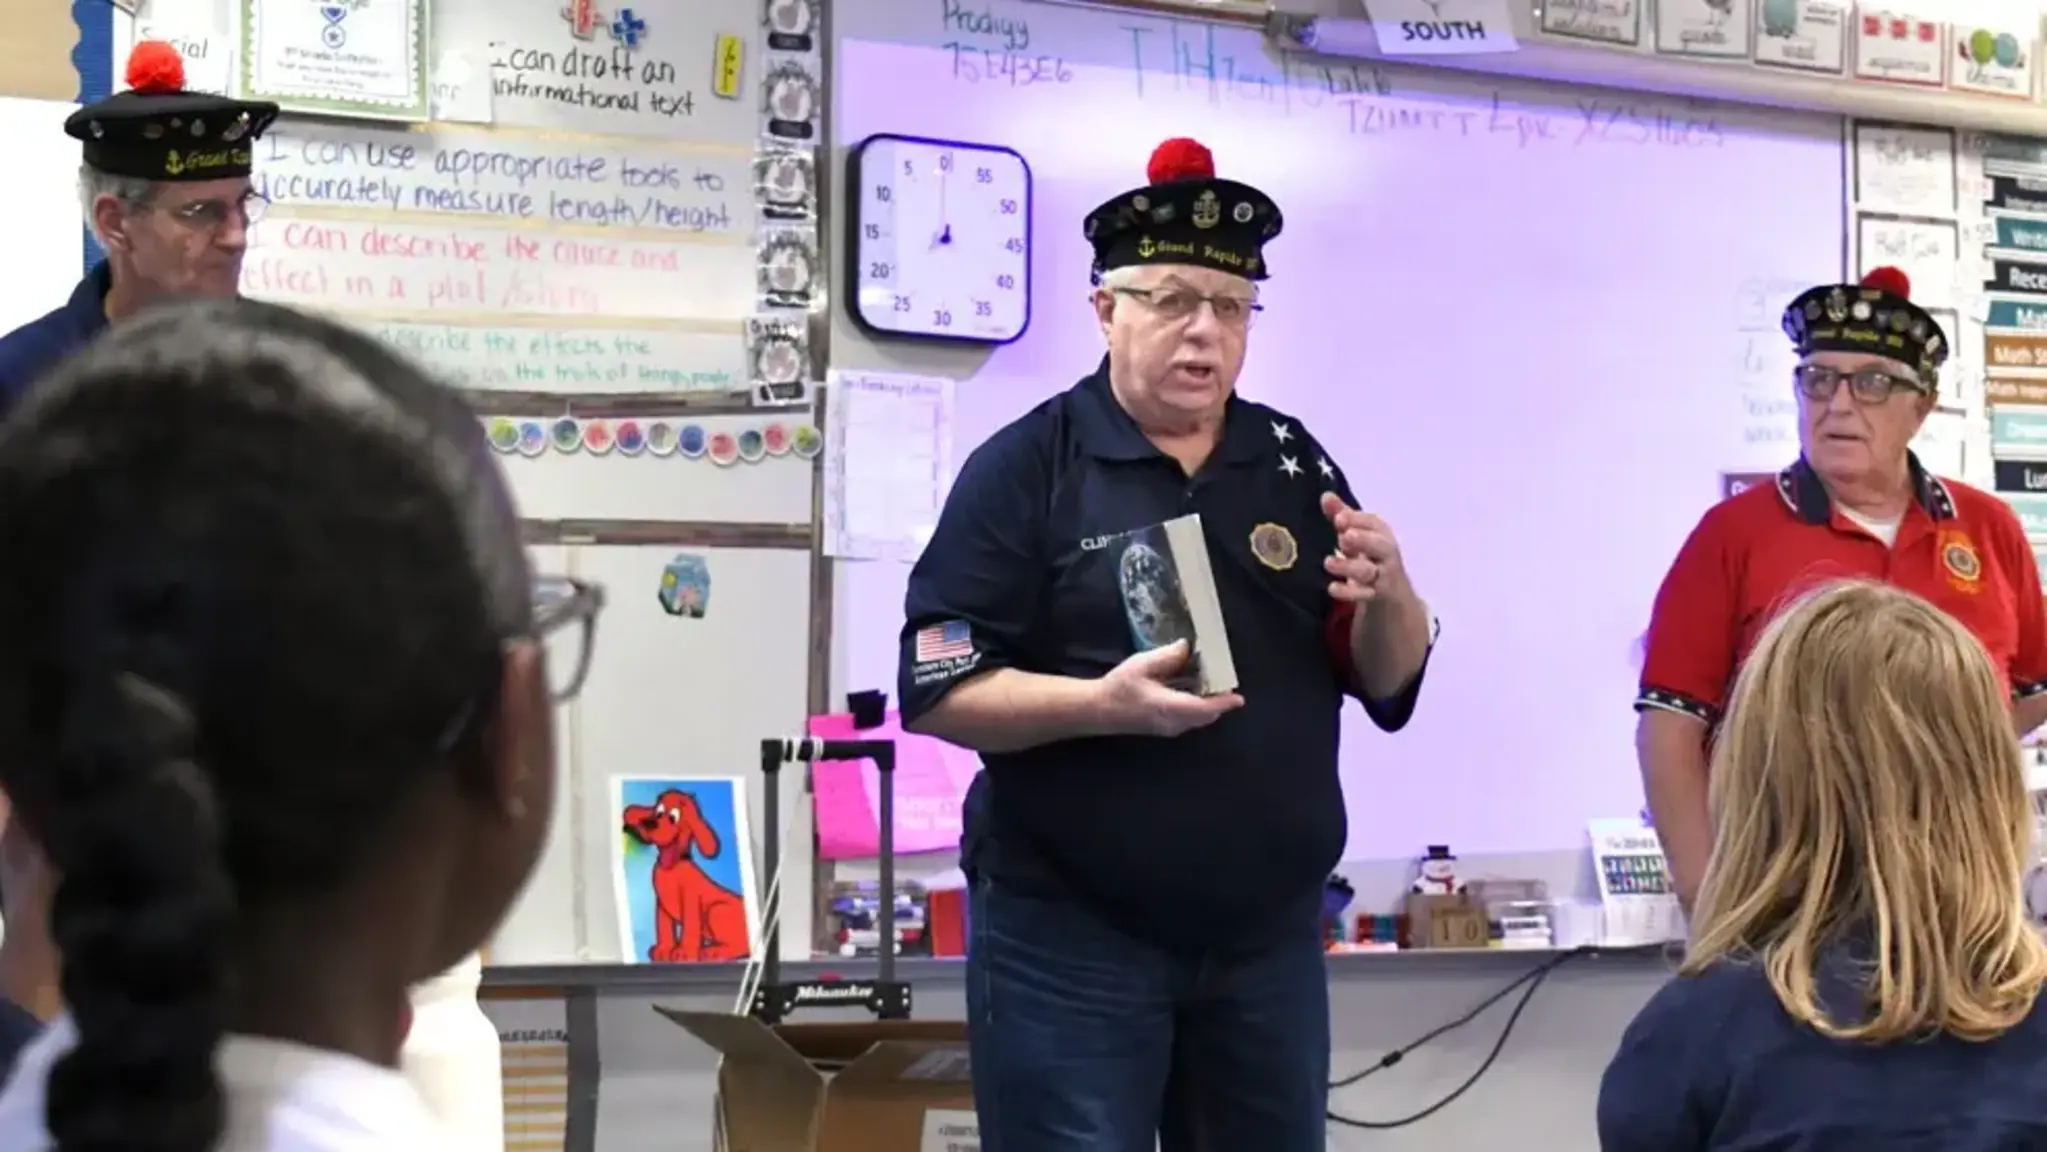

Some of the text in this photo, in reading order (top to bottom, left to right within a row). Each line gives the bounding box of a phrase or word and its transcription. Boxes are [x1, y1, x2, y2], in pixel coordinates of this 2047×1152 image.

[939, 0, 1030, 51] Prodigy
[1401, 20, 1485, 40] SOUTH
[509, 48, 556, 71] can
[563, 46, 635, 82] draft
[642, 61, 676, 84] an
[650, 92, 696, 117] text
[264, 130, 724, 192] I can use appropriate tools to
[904, 160, 913, 176] 5
[976, 167, 993, 184] 55
[876, 185, 891, 202] 10
[415, 184, 534, 218] measure
[549, 191, 731, 234] length/height
[1000, 199, 1018, 214] 50
[865, 223, 880, 239] 15
[284, 222, 347, 250] can
[361, 225, 490, 262] describe
[504, 234, 540, 262] the
[553, 240, 621, 267] cause
[631, 249, 681, 271] and
[1005, 238, 1024, 254] 45
[1157, 240, 1195, 256] Grand
[1203, 245, 1242, 267] Rapids
[242, 257, 328, 292] effect
[346, 274, 374, 297] in
[388, 275, 406, 298] a
[870, 262, 890, 279] 20
[2008, 267, 2047, 289] Rece
[996, 274, 1014, 290] 40
[894, 296, 911, 312] 25
[976, 301, 992, 317] 35
[933, 310, 952, 326] 30
